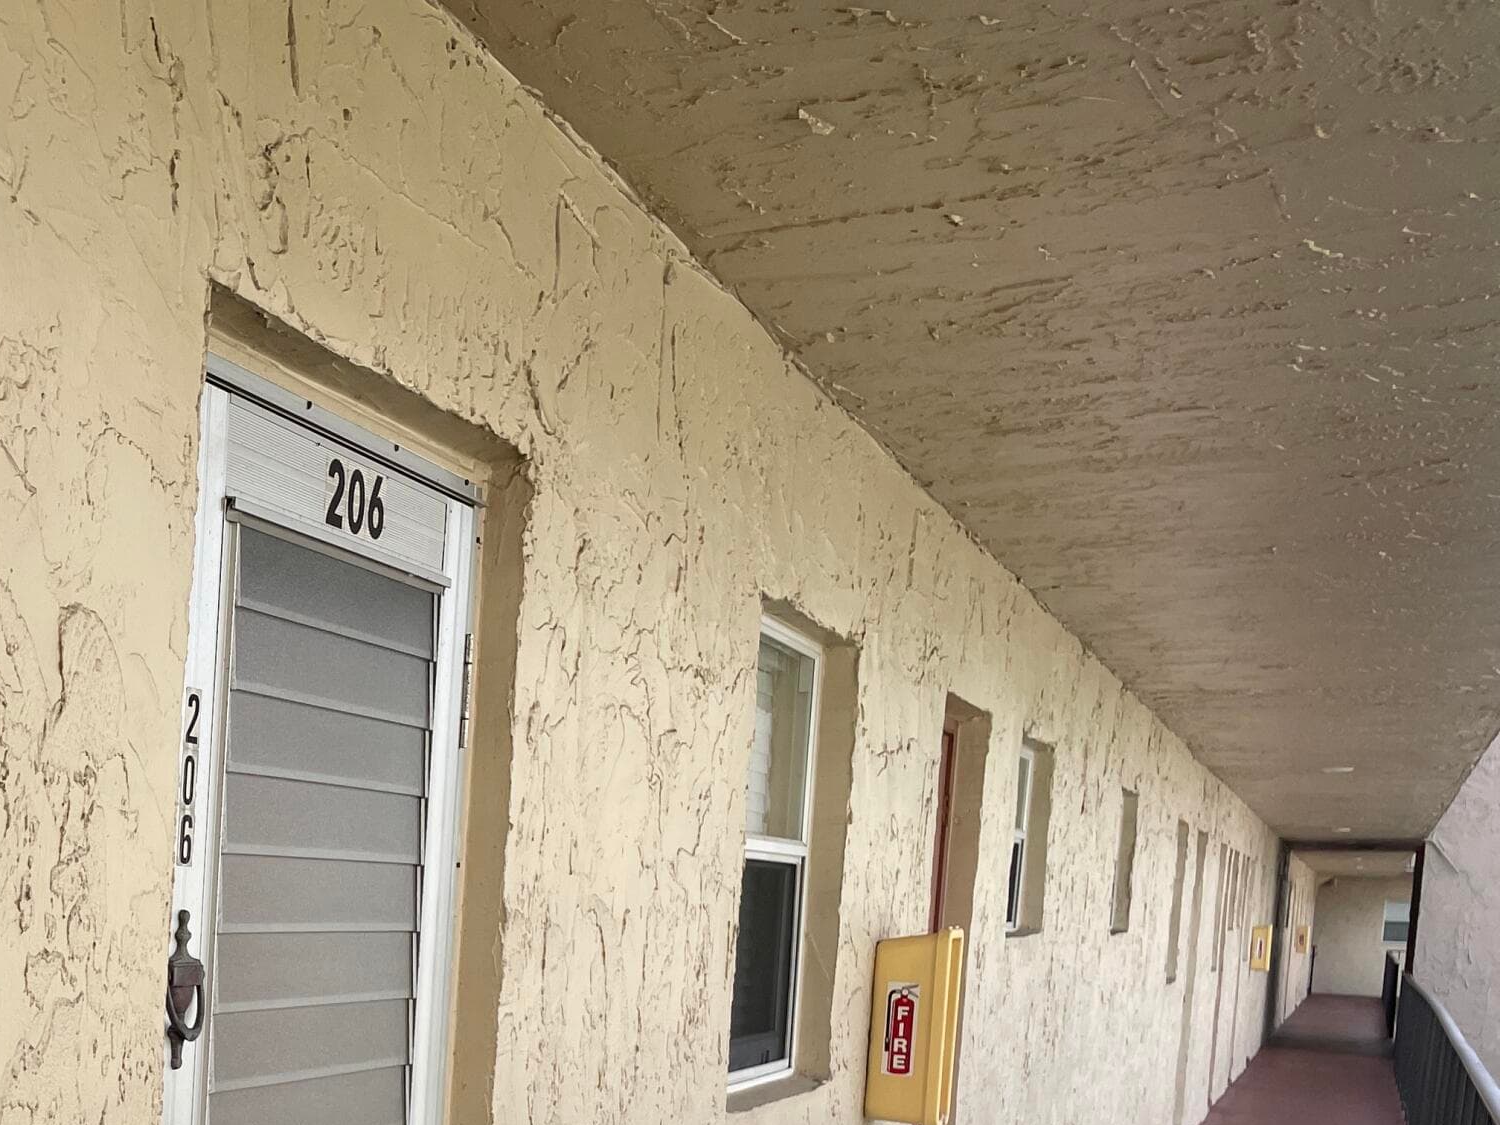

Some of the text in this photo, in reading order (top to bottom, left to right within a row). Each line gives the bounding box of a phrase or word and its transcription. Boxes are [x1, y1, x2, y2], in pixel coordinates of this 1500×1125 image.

[325, 458, 384, 540] 206
[179, 693, 200, 865] 206
[892, 1005, 910, 1070] FIRE
